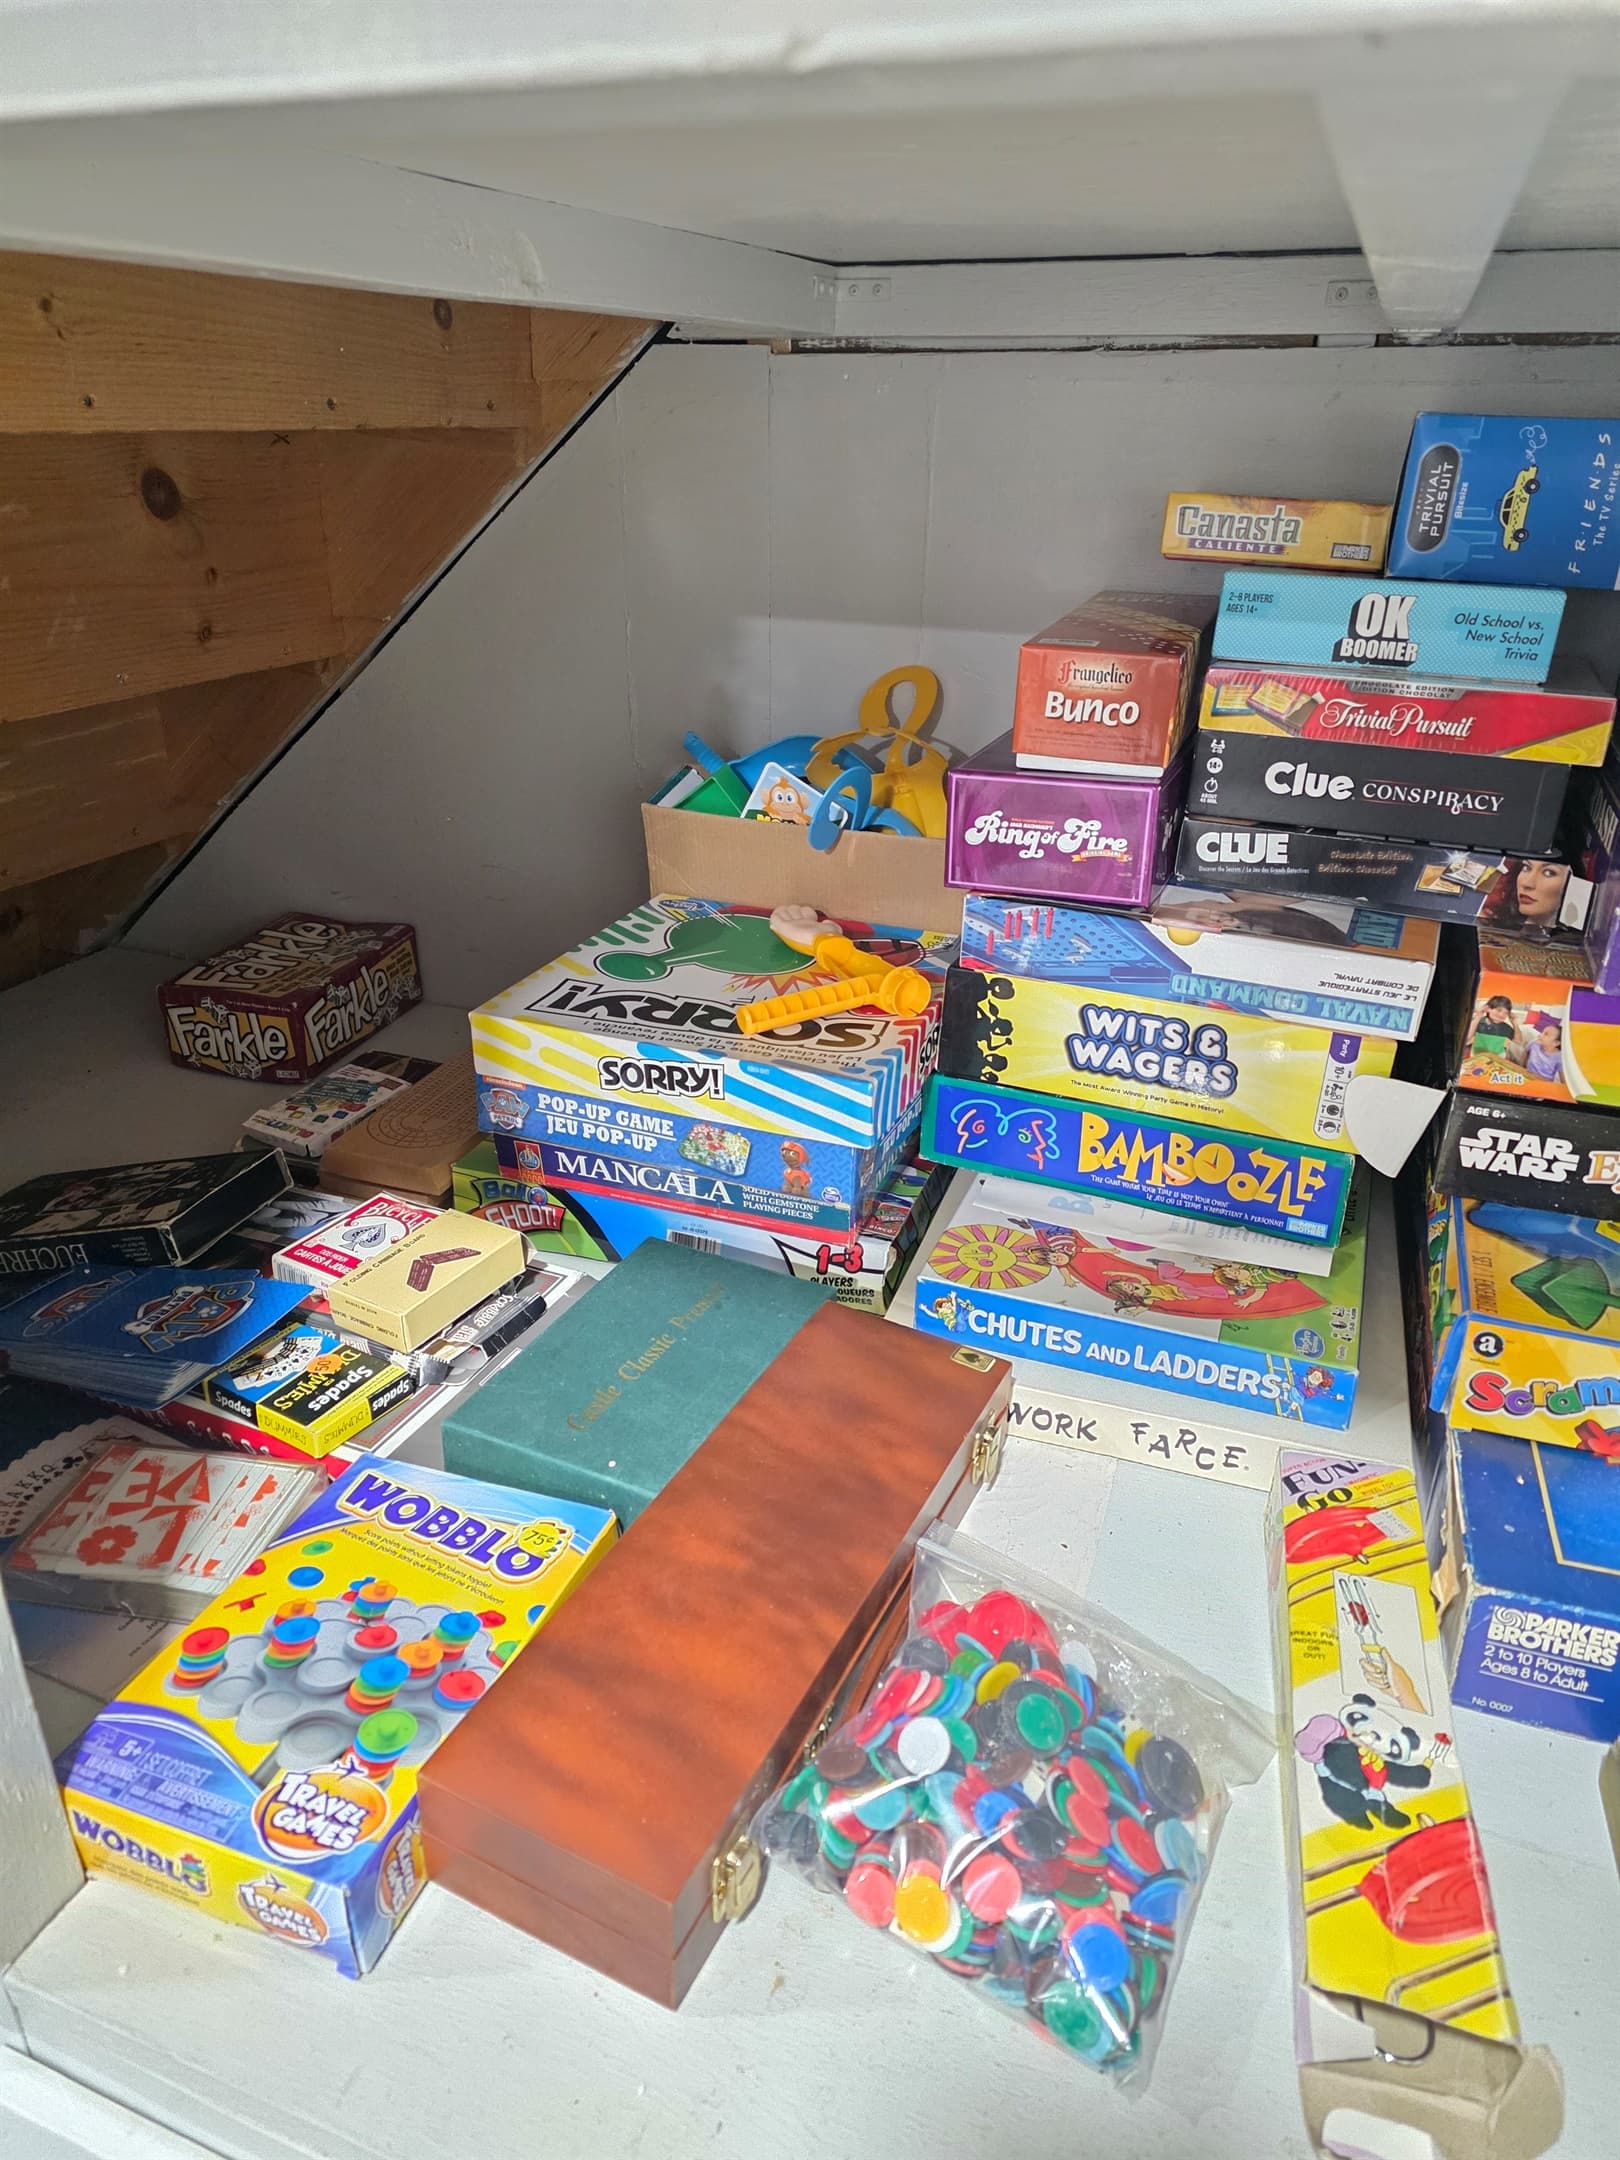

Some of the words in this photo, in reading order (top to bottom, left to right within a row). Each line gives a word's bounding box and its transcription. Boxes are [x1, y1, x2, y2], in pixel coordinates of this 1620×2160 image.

[1419, 464, 1442, 532] TRIVIAL
[1430, 462, 1454, 537] PURSUIT
[1454, 482, 1469, 519] Bitesize
[1177, 505, 1302, 544] Canasta
[1599, 507, 1611, 521] TV
[1194, 540, 1277, 554] CALIENTE
[1593, 524, 1607, 546] The
[1226, 604, 1244, 613] AGES
[1246, 605, 1258, 614] 14+
[1244, 593, 1274, 604] PLAYERS
[1354, 592, 1418, 640] OK
[1454, 612, 1477, 625] Old
[1481, 615, 1523, 629] School
[1528, 619, 1544, 631] vs.
[1338, 637, 1419, 663] BOOMER
[1465, 630, 1496, 642] New
[1499, 633, 1543, 646] School
[1505, 648, 1538, 661] Trivia
[1058, 659, 1133, 685] Frangelico
[1415, 684, 1455, 693] EDITION
[1320, 698, 1396, 731] Trivial
[1390, 702, 1473, 737] Pursuit
[1264, 761, 1355, 800] Clue
[1362, 782, 1504, 814] CONSPIRACY
[965, 810, 1045, 858] Ring
[1040, 831, 1060, 844] of
[1057, 818, 1128, 853] Fire
[1196, 831, 1289, 864] CLUE
[175, 922, 342, 991] Farkle
[1334, 973, 1364, 985] NAVAL
[1366, 979, 1404, 991] COMBAT
[1170, 974, 1308, 1015] COMMAND
[1382, 991, 1402, 1000] JEU
[1403, 994, 1417, 1002] LE
[304, 966, 390, 1065] Farkle
[1315, 996, 1411, 1031] NAVAL
[167, 1004, 288, 1064] Farkle
[592, 1022, 658, 1035] revanche
[592, 1026, 661, 1042] Revenge
[664, 1030, 703, 1043] douce
[708, 1037, 722, 1045] la
[1085, 1007, 1186, 1052] WITS
[1198, 1027, 1224, 1059] &
[665, 1036, 703, 1049] Sweet
[707, 1043, 726, 1051] Of
[725, 1040, 743, 1048] de
[732, 1046, 773, 1058] Game
[748, 1042, 817, 1058] classique
[1340, 1039, 1351, 1058] Party
[776, 1053, 827, 1065] Classic
[821, 1051, 843, 1061] jeu
[830, 1058, 858, 1068] The
[848, 1055, 862, 1063] Le
[1070, 1036, 1234, 1094] WAGERS
[599, 1058, 723, 1098] SORRY!
[1334, 1066, 1344, 1080] 10+
[1489, 1072, 1511, 1084] Act
[1512, 1073, 1524, 1085] it
[1100, 1085, 1121, 1094] Award
[1123, 1090, 1149, 1101] Winning
[1150, 1095, 1168, 1104] Party
[1169, 1099, 1189, 1108] Game
[537, 1093, 611, 1122] POP-UP
[616, 1108, 674, 1136] GAME
[1467, 1106, 1489, 1117] AGE
[1492, 1109, 1507, 1120] 6+
[546, 1115, 577, 1136] JEU
[582, 1126, 657, 1152] POP-UP
[1459, 1127, 1580, 1163] STAR
[1078, 1111, 1326, 1216] BAMBOOZLE
[1459, 1145, 1579, 1183] WARS
[555, 1150, 734, 1205] MANCALA
[1090, 1174, 1103, 1183] THE
[1104, 1176, 1121, 1186] GAME
[1141, 1184, 1157, 1194] YOUR
[1157, 1186, 1172, 1197] TIME
[1173, 1190, 1179, 1198] IS
[1180, 1192, 1194, 1201] NOT
[1195, 1195, 1210, 1204] YOUR
[743, 1192, 767, 1204] WITH
[768, 1197, 819, 1213] GEMSTONE
[743, 1201, 781, 1215] PLAYING
[782, 1208, 814, 1220] PIECES
[1146, 1193, 1153, 1201] LE
[1154, 1194, 1165, 1203] JEU
[1184, 1201, 1201, 1211] TEMPS
[485, 1203, 557, 1228] SHOOT!
[293, 1248, 325, 1264] CARTES
[816, 1242, 864, 1275] 1-3
[343, 1268, 373, 1287] FOLDING
[618, 1332, 676, 1381] Classic
[966, 1308, 1082, 1355] CHUTES
[1085, 1342, 1131, 1366] AND
[1134, 1343, 1283, 1401] LADDERS
[308, 1365, 374, 1412] Spades
[372, 1379, 410, 1412] Spades
[215, 1391, 253, 1418] Spades
[263, 1414, 307, 1446] DUMMIES
[324, 1411, 365, 1444] DUMMIES
[1007, 1401, 1098, 1442] WORK
[1297, 1487, 1353, 1513] GO
[343, 1472, 546, 1579] WOBBLO
[1488, 1620, 1617, 1667] BROTHERS
[1522, 1611, 1620, 1650] PARKER
[1483, 1644, 1496, 1657] 2
[1499, 1648, 1514, 1661] to
[1517, 1651, 1533, 1666] 10
[1535, 1655, 1587, 1679] Players
[1480, 1658, 1518, 1677] Ages
[1520, 1668, 1531, 1680] 8
[1532, 1670, 1549, 1684] to
[1549, 1674, 1589, 1693] Adult
[119, 1739, 144, 1757] 5+
[276, 1772, 369, 1826] TRAVEL
[272, 1806, 360, 1850] GAMES
[239, 1884, 314, 1927] TRAVEL
